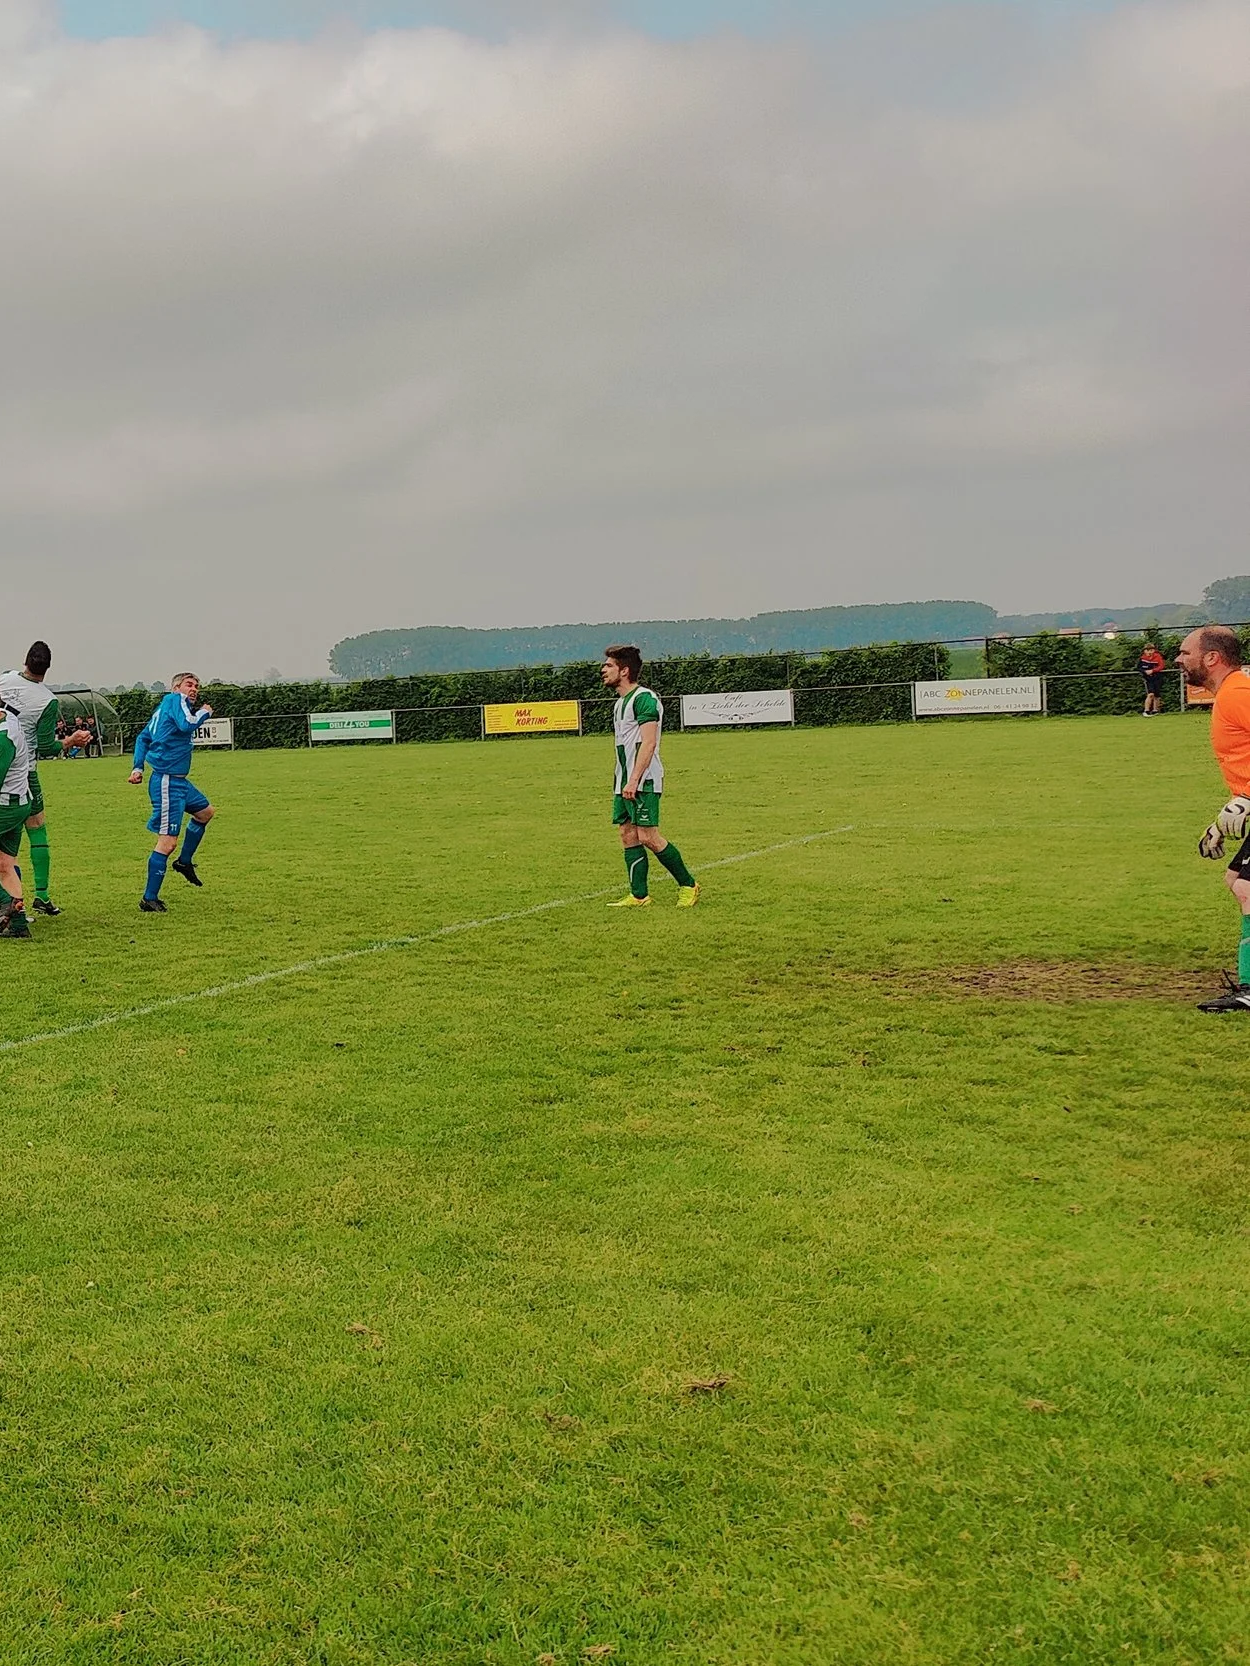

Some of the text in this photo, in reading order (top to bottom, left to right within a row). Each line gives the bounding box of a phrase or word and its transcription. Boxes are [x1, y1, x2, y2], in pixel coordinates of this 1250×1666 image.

[923, 687, 1033, 698] ABC ZONNEPANELEN.NL
[514, 709, 532, 717] MAX
[516, 717, 548, 726] KORTING
